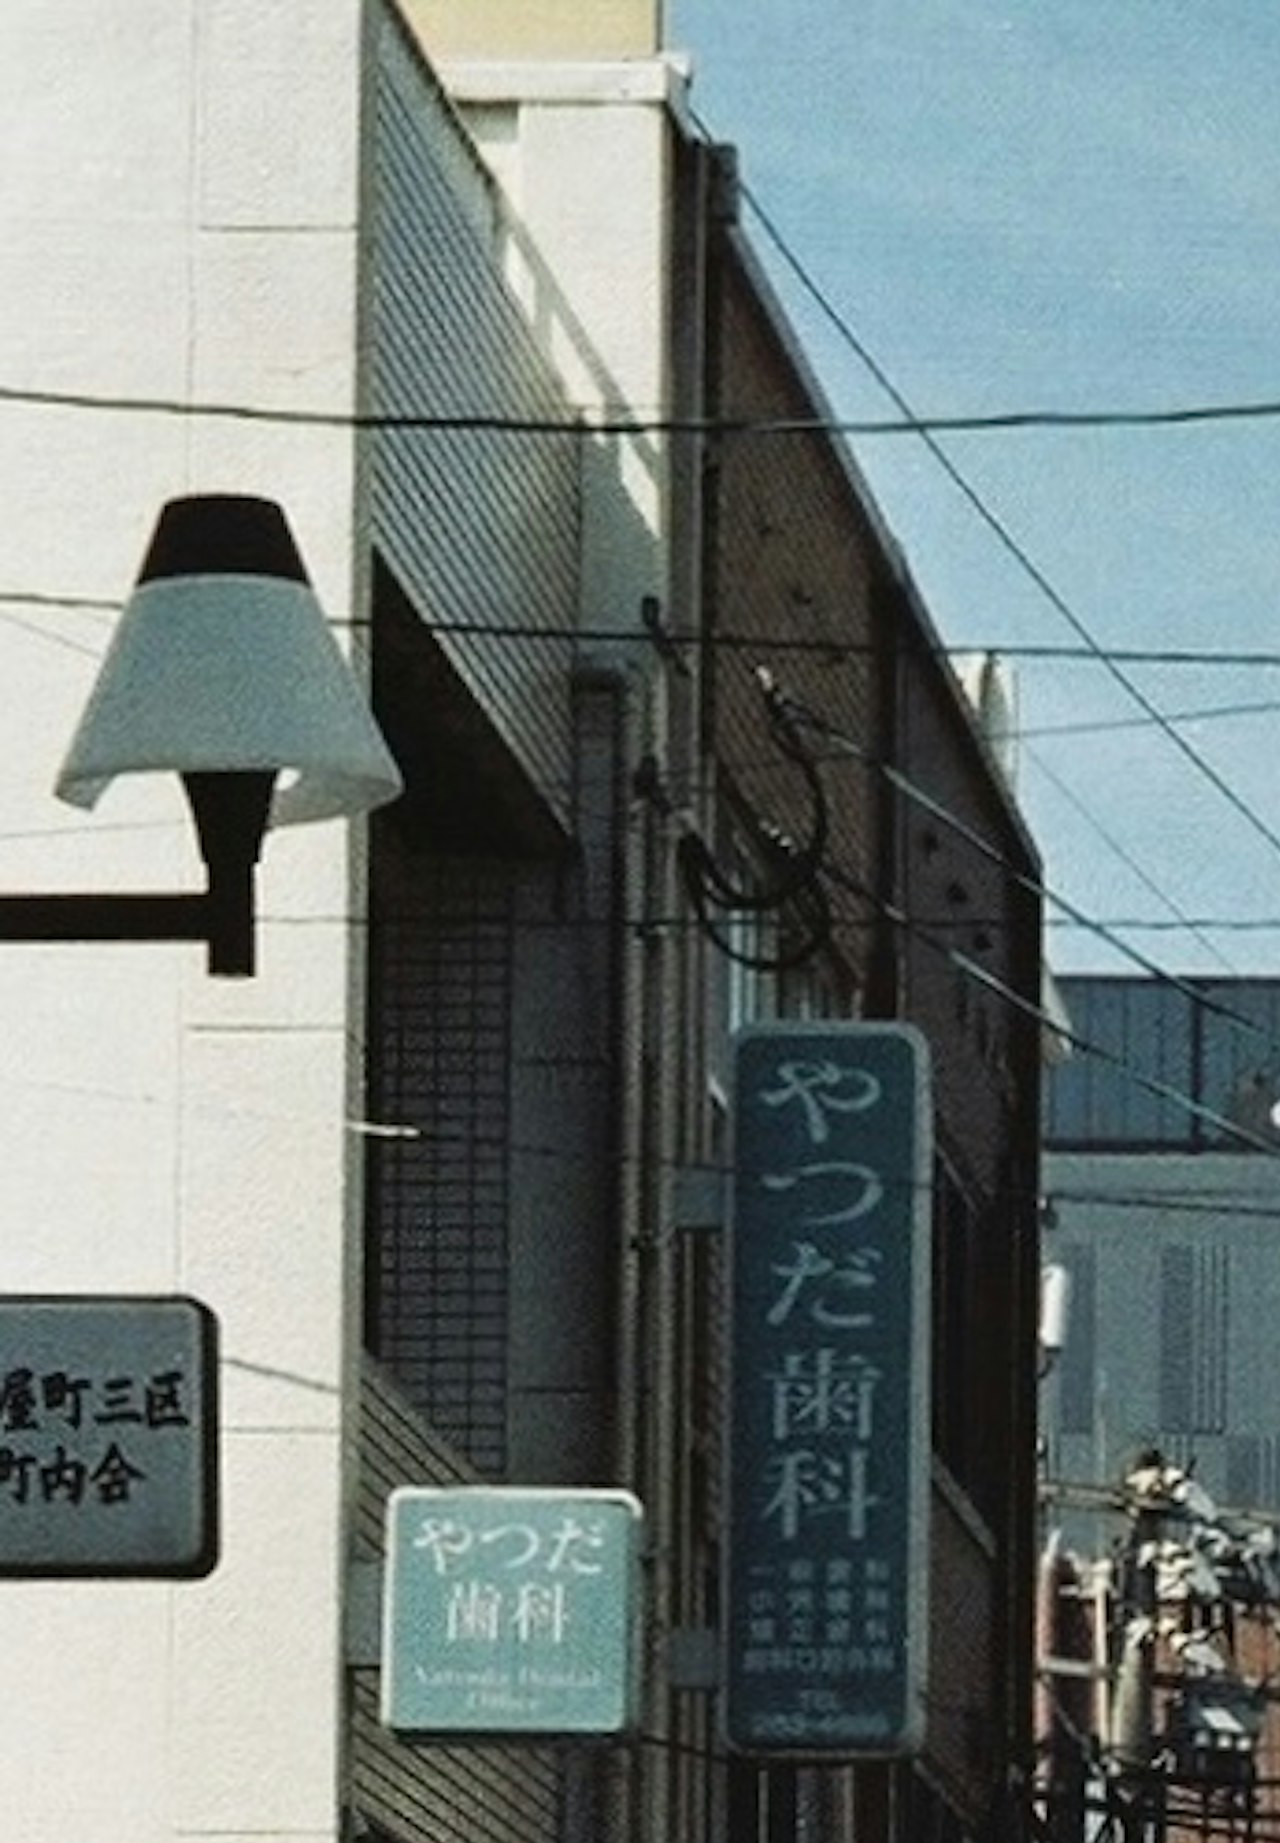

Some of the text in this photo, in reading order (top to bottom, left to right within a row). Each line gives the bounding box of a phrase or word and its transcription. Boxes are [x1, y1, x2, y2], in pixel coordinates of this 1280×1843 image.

[757, 1059, 884, 1542] やつだ歯科
[0, 1367, 190, 1431] 屋町三区
[412, 1516, 603, 1575] やつだ
[447, 1581, 571, 1642] 歯科
